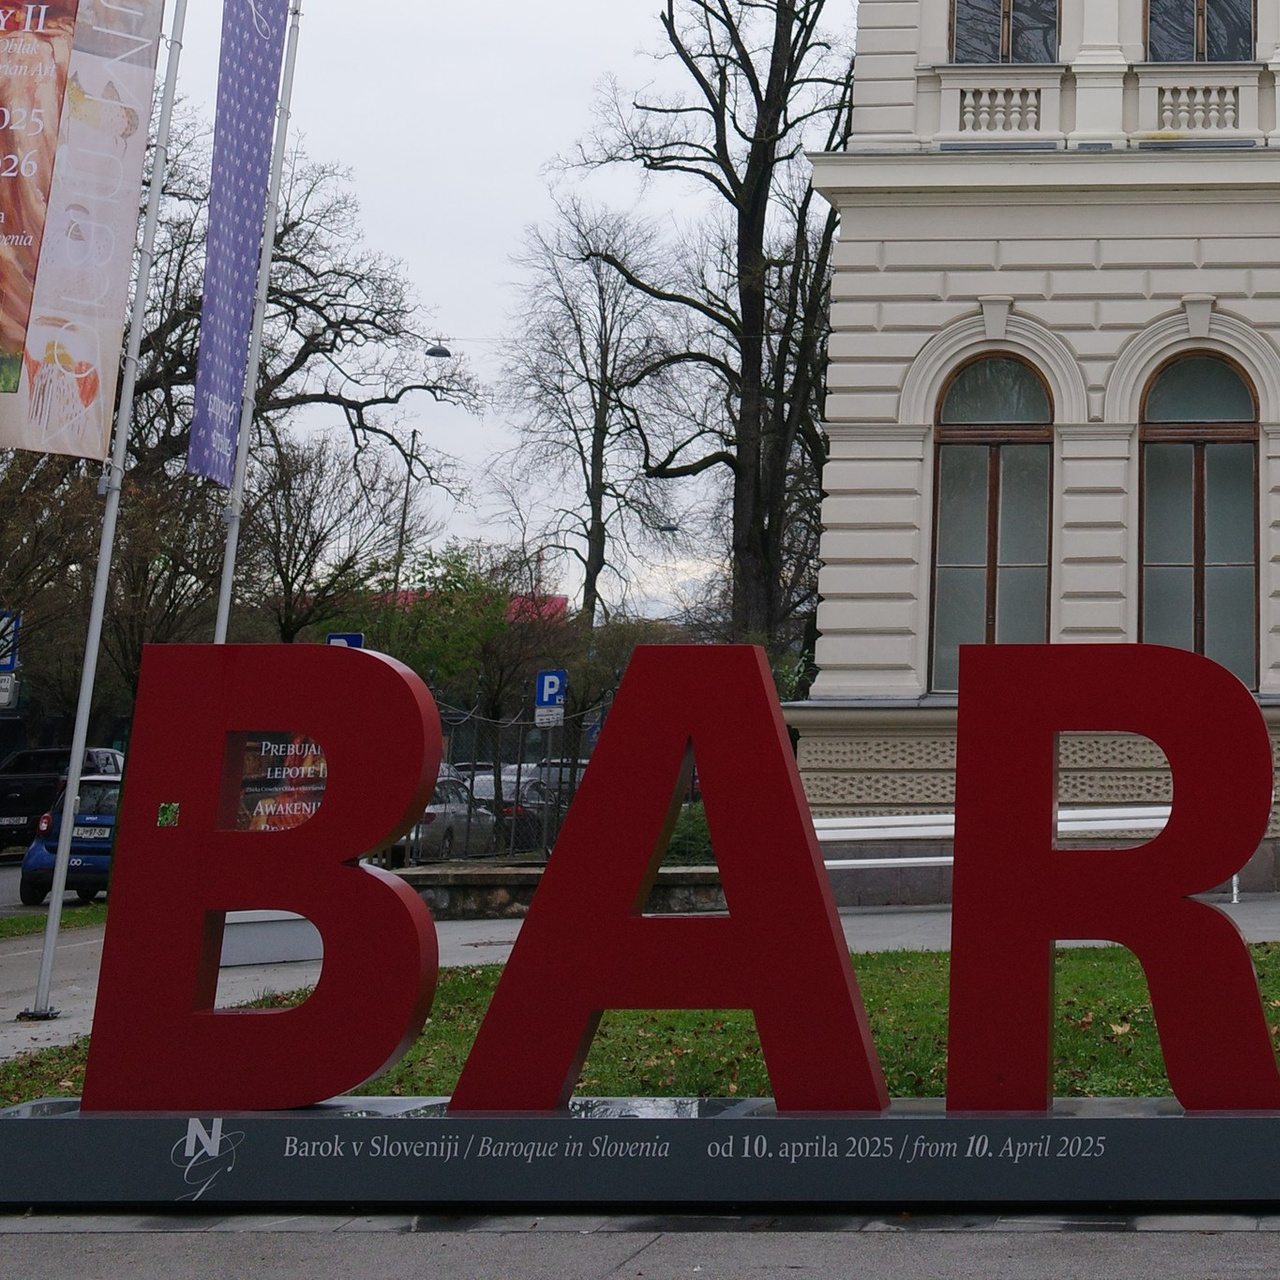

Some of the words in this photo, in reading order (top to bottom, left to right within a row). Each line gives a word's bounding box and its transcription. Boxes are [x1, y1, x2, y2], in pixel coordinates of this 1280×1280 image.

[22, 4, 50, 33] II
[0, 149, 38, 177] 26
[543, 675, 560, 702] P
[283, 1135, 345, 1158] Barok
[352, 1142, 363, 1158] v
[369, 1135, 459, 1163] Sloveniji
[477, 1136, 558, 1164] Baroque
[564, 1136, 583, 1158] in
[588, 1136, 670, 1158] Slovenia
[707, 1134, 734, 1158] od
[740, 1135, 773, 1158] 10.
[779, 1134, 838, 1163] aprila
[845, 1136, 894, 1158] 2025
[910, 1135, 958, 1163] from
[964, 1135, 994, 1158] 10.
[998, 1134, 1051, 1163] April
[1056, 1135, 1106, 1158] 2025
